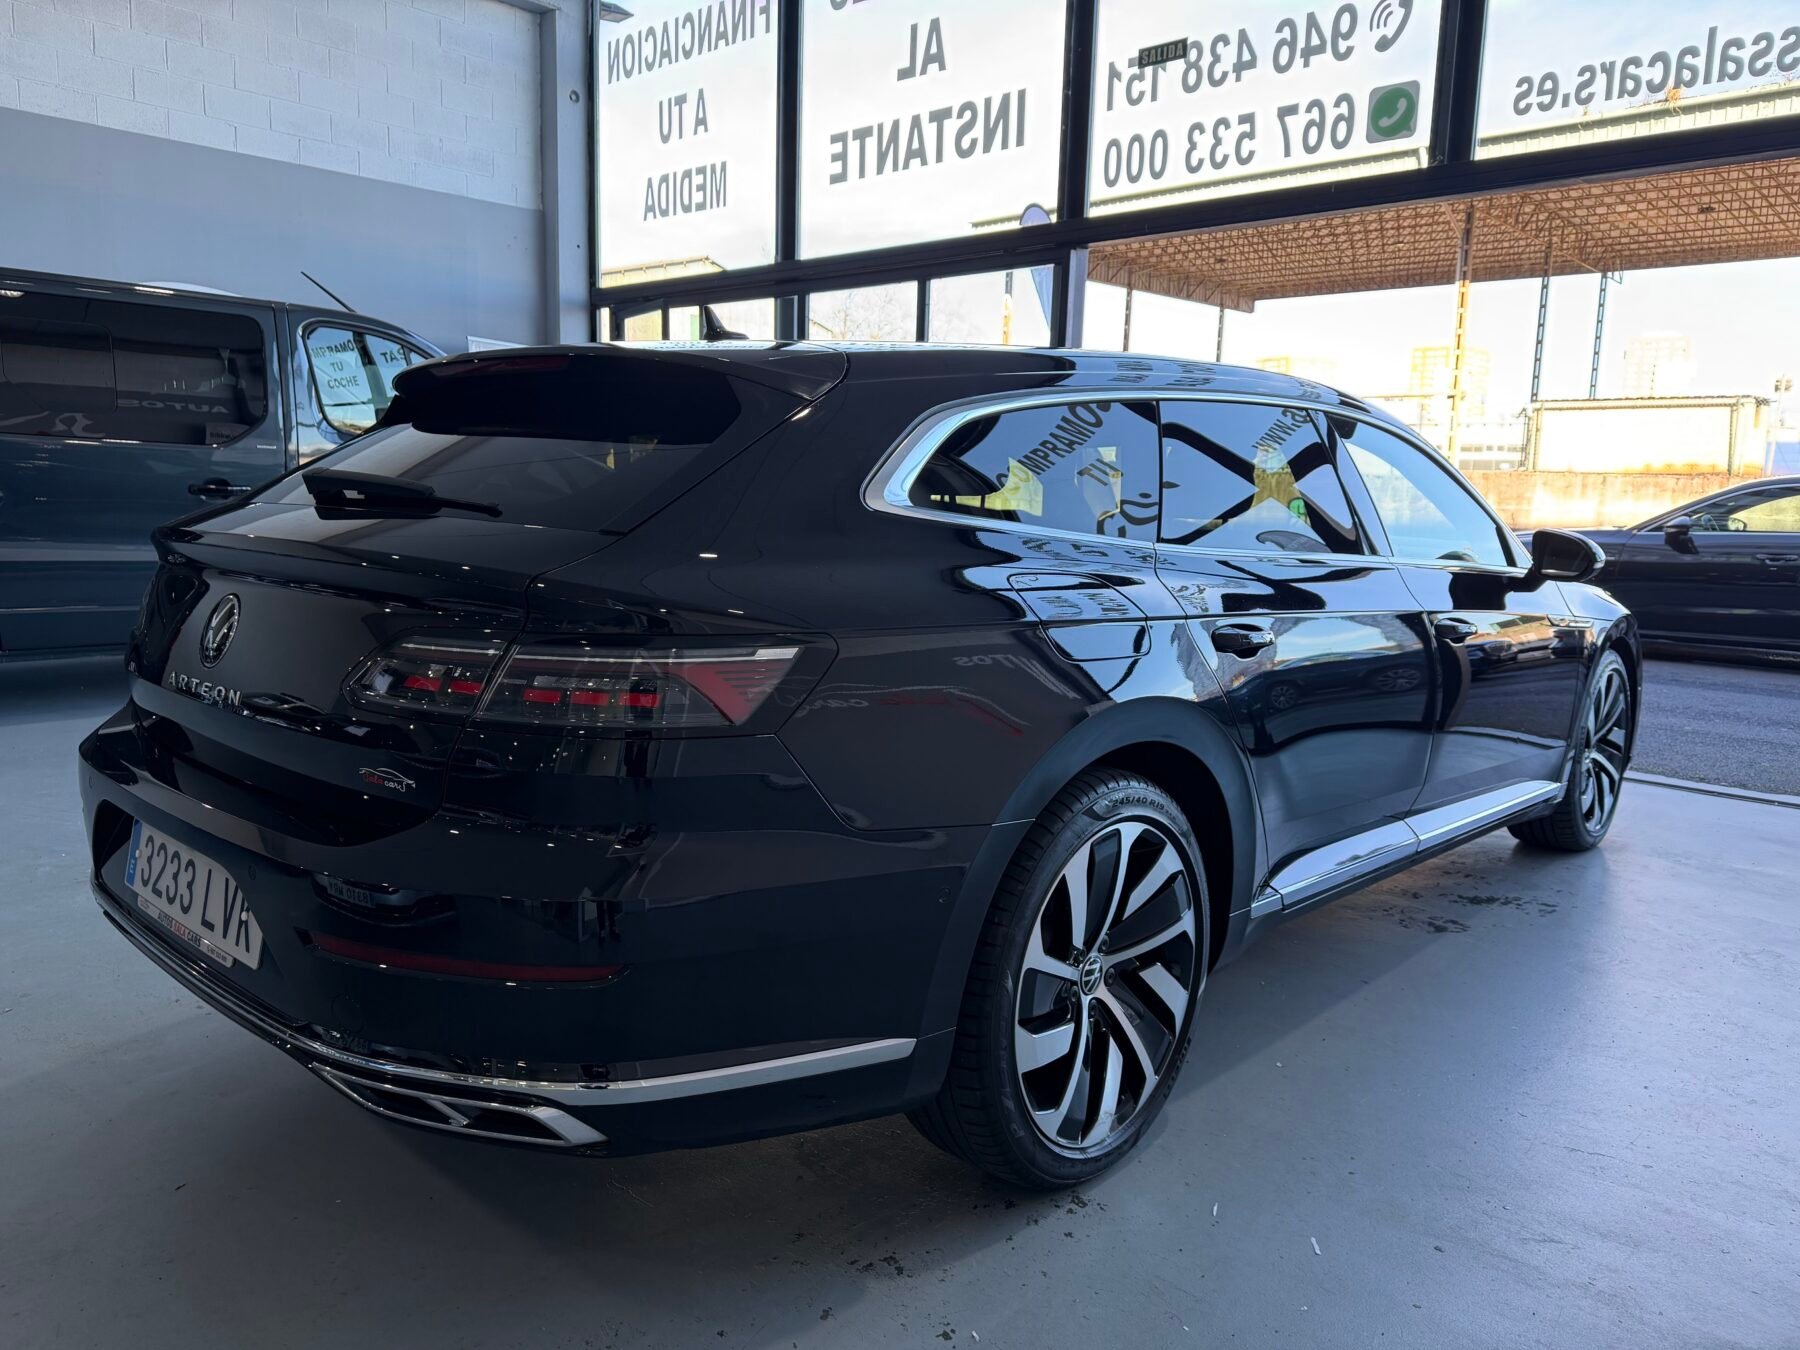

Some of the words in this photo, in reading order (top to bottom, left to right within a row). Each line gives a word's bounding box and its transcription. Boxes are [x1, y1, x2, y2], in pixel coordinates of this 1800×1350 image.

[1140, 41, 1184, 66] SALIDA
[168, 671, 243, 707] ARTEON
[1112, 796, 1148, 808] 245/40
[140, 834, 197, 915] 3233
[187, 931, 201, 948] CARS
